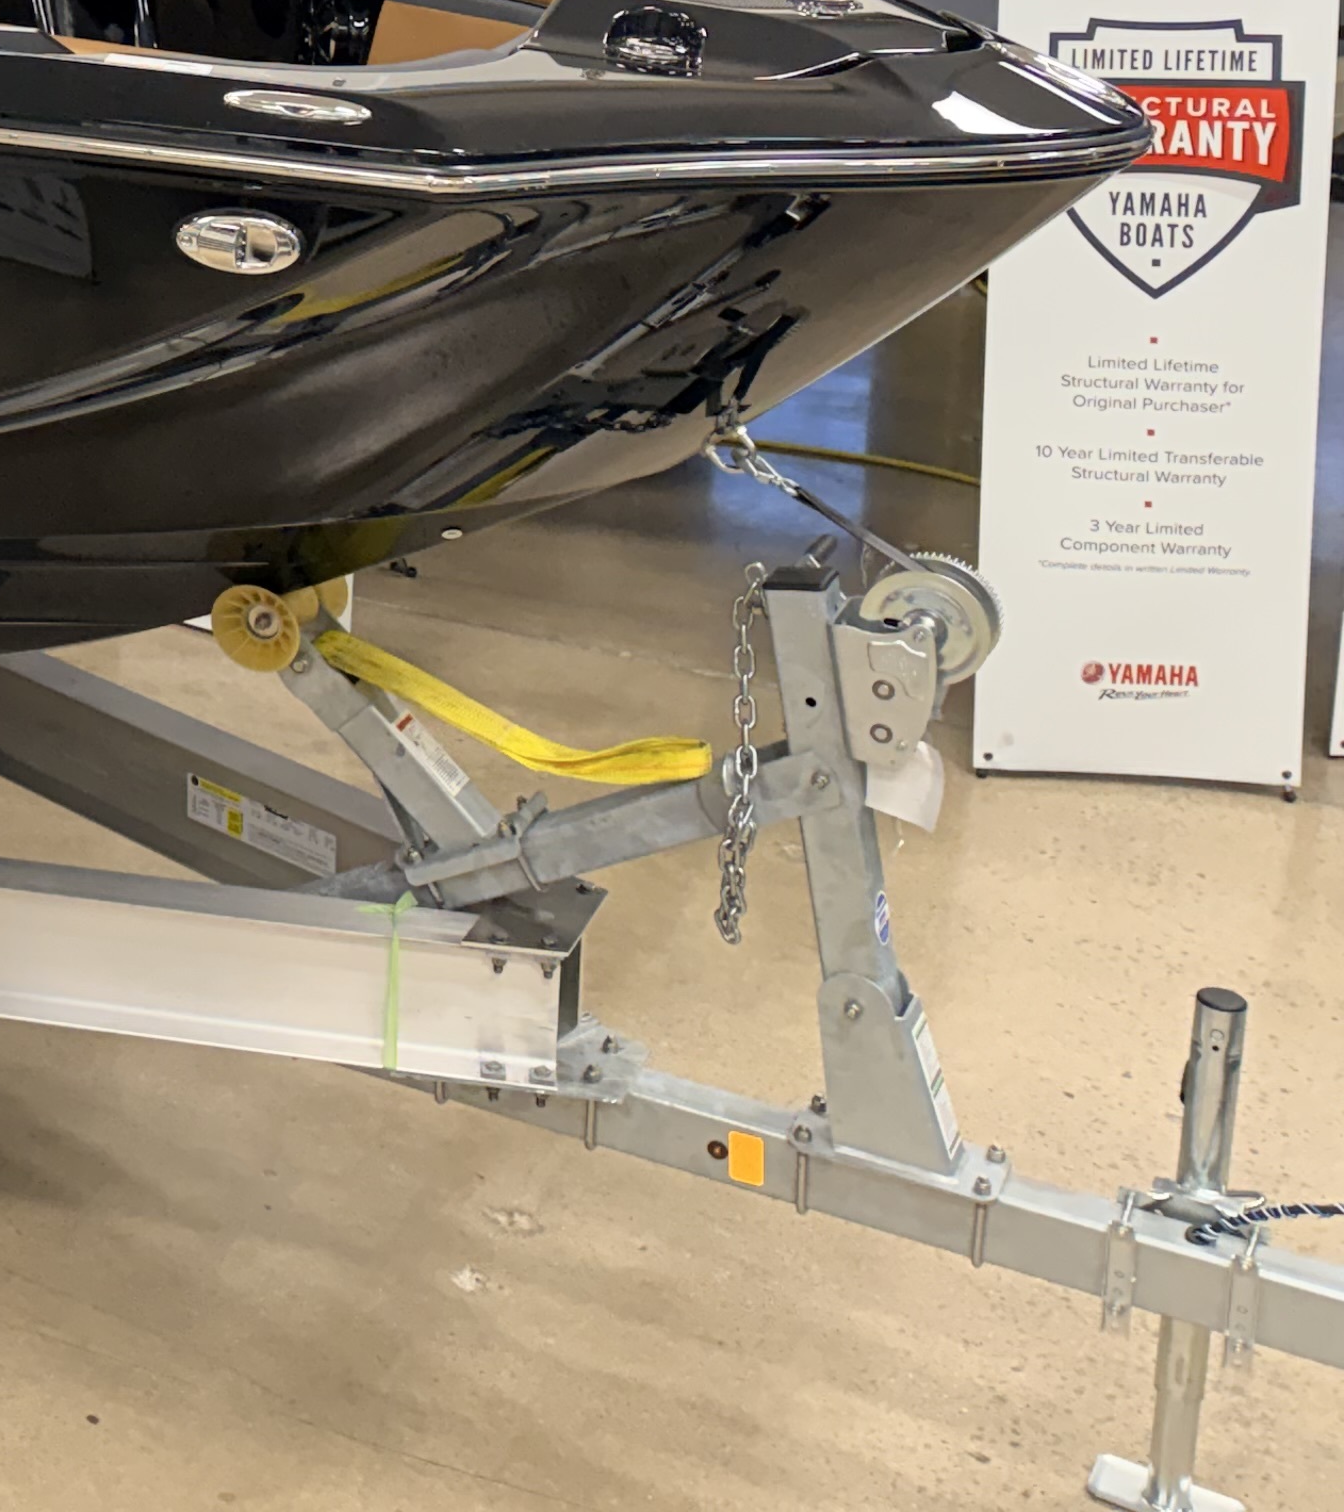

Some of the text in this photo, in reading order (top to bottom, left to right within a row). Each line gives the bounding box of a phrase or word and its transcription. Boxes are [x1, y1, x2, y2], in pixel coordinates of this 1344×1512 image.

[1071, 48, 1258, 72] LIMITED LIFETIME
[1141, 96, 1277, 119] CTURAL
[1147, 119, 1277, 166] RANTY
[1109, 191, 1208, 218] YAMAHA
[1119, 222, 1194, 249] BOATS
[1088, 355, 1219, 373] Limited Lifetime
[1061, 374, 1245, 396] Structural Warranty for
[1072, 394, 1137, 411] Original
[1035, 445, 1265, 466] 10 Year Limited Transferable
[1071, 466, 1227, 487] Structural Warranty
[1089, 519, 1205, 536] 3 Year Limited
[1059, 537, 1232, 558] Component Warranty
[1108, 663, 1199, 687] YAMAHA
